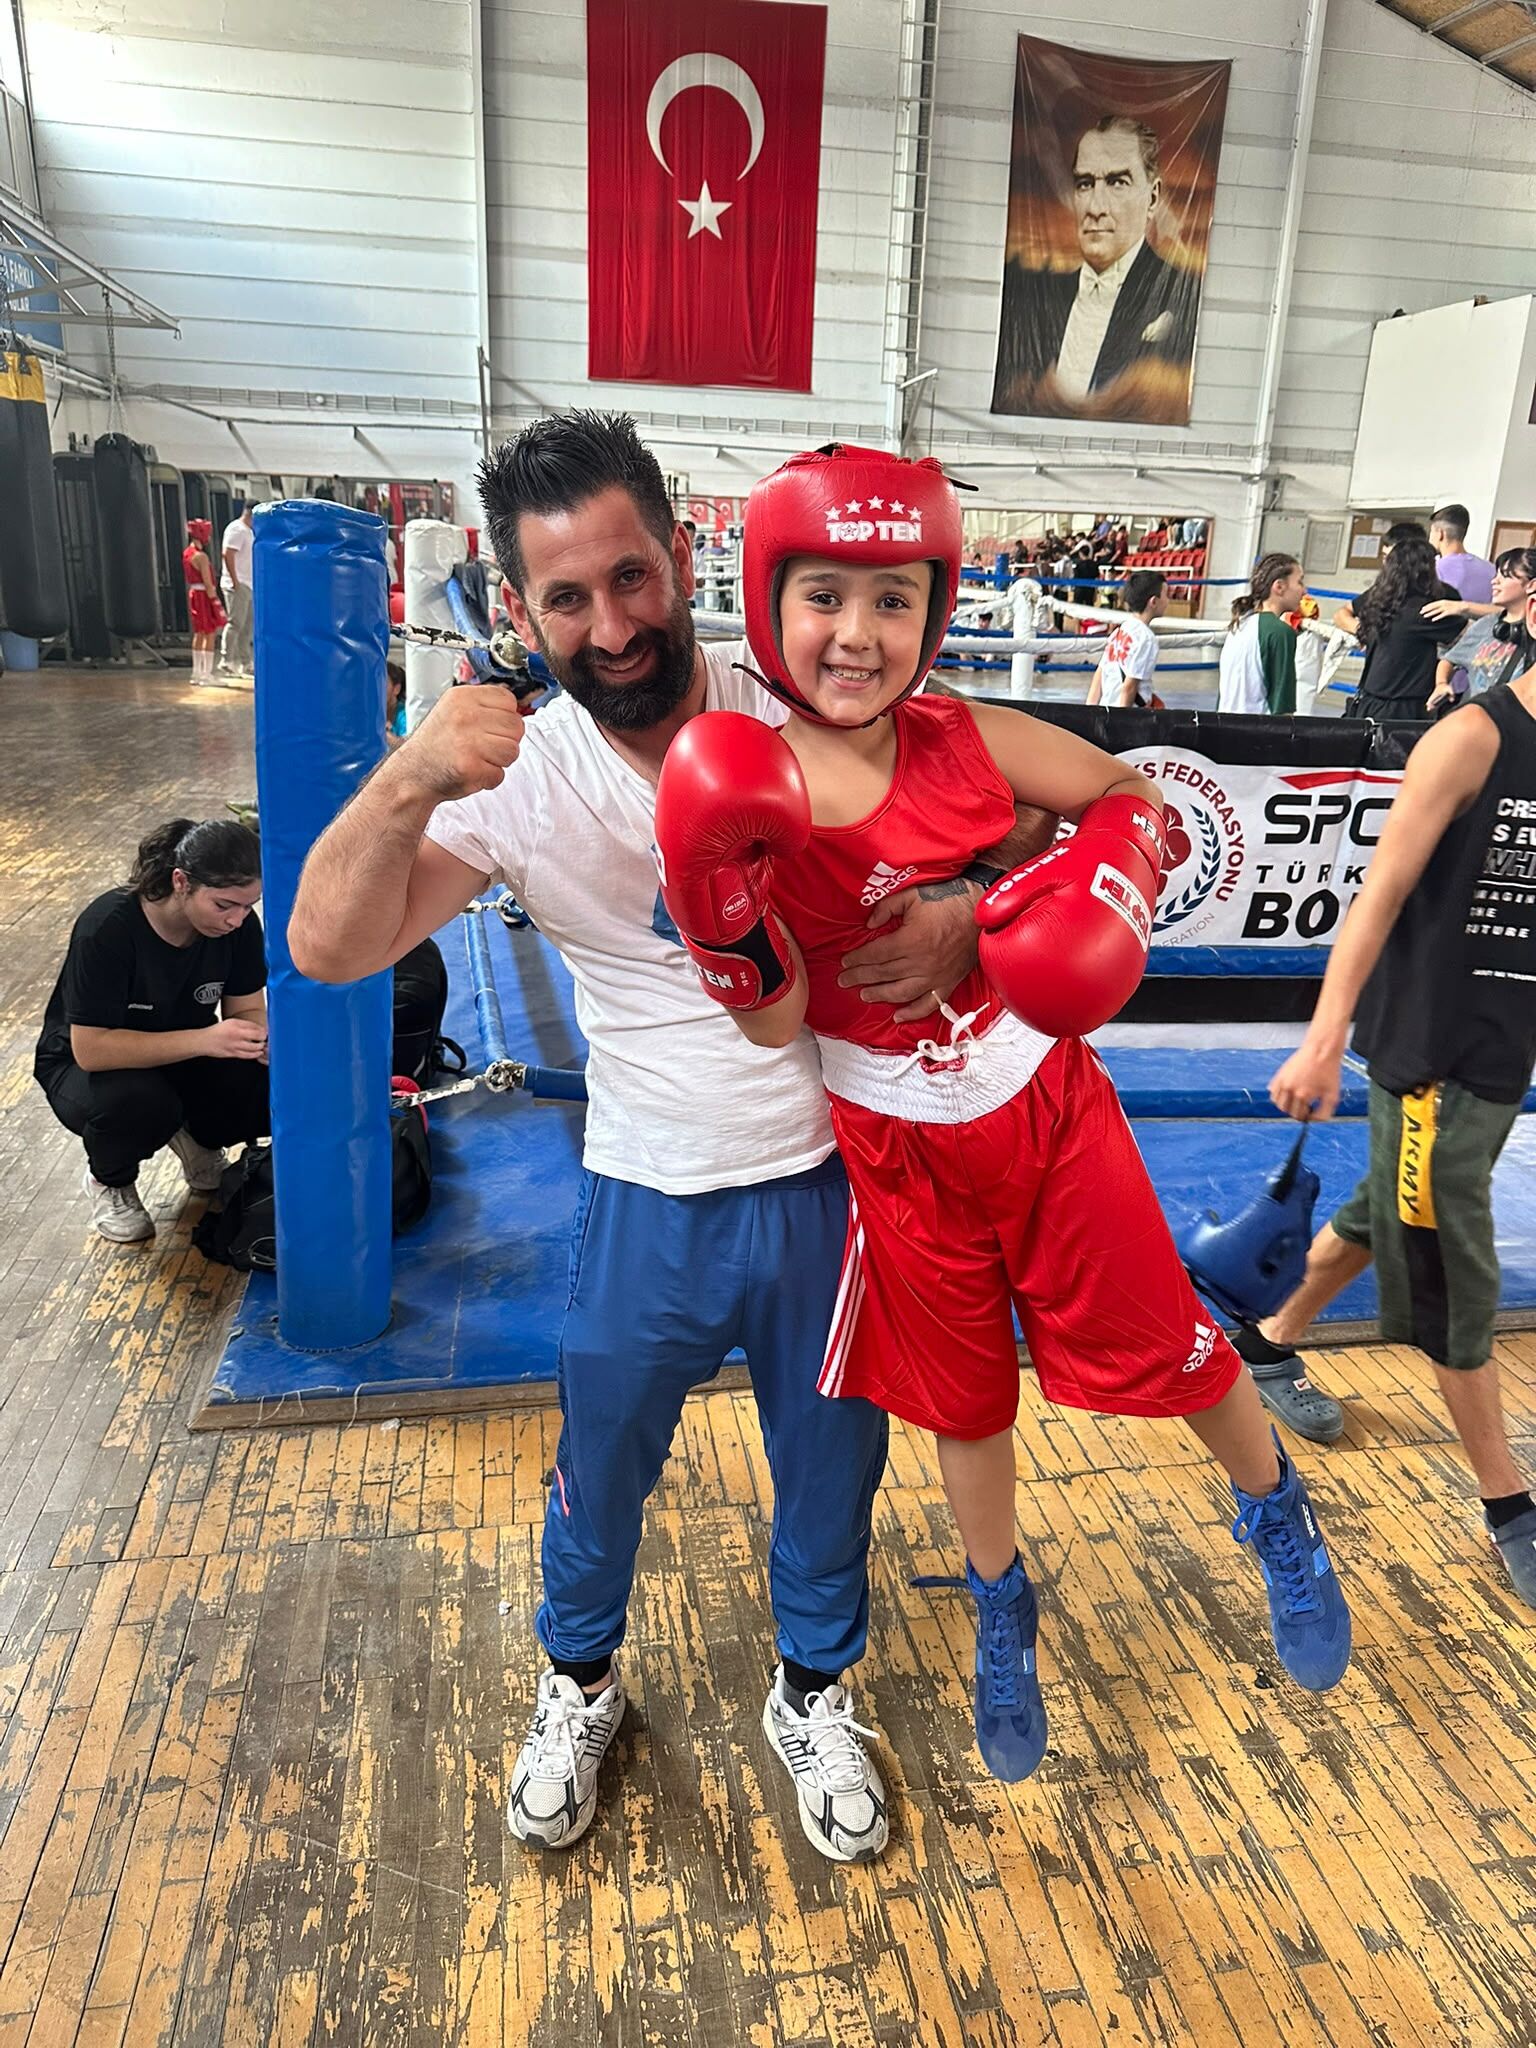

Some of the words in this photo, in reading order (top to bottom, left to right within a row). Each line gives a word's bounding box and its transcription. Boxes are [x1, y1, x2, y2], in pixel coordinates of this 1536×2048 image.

[826, 520, 875, 543] TOP
[875, 520, 922, 543] TEN
[1162, 762, 1244, 902] FEDERASYONU
[860, 865, 919, 907] adidas
[1099, 874, 1132, 912] TEN
[1241, 889, 1359, 939] BO
[1402, 1110, 1422, 1216] ARMY
[1182, 1328, 1218, 1372] adidas
